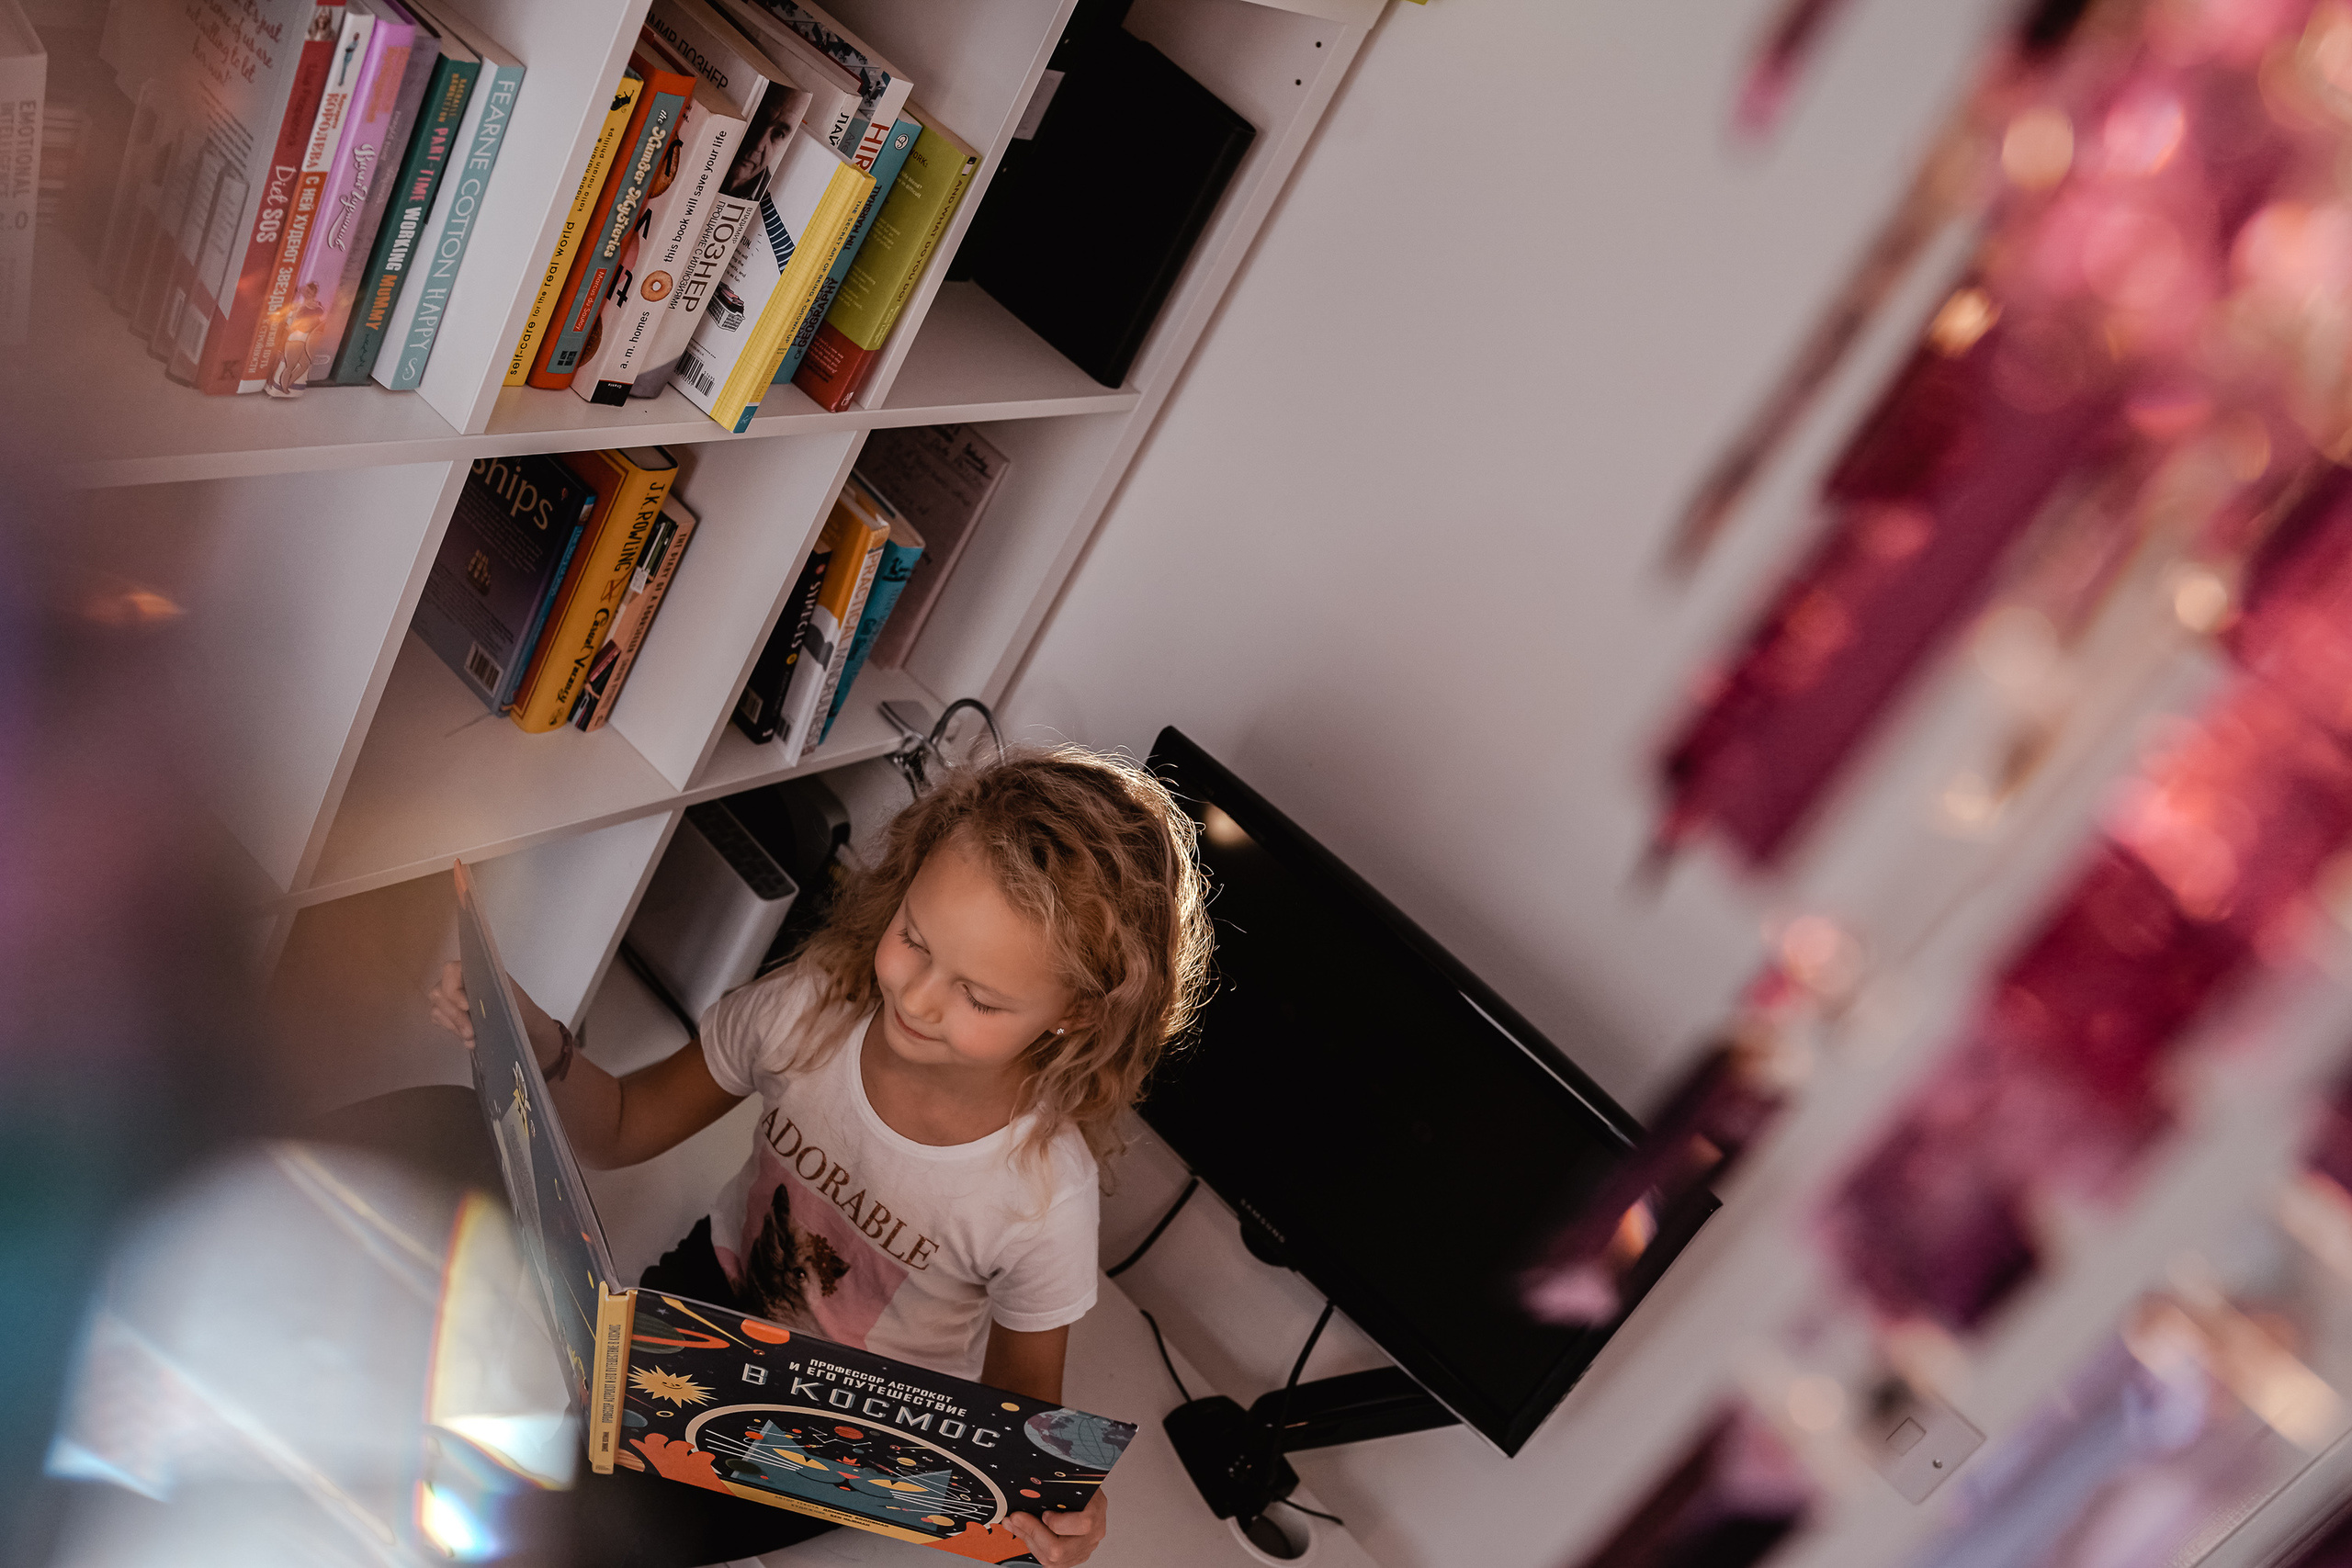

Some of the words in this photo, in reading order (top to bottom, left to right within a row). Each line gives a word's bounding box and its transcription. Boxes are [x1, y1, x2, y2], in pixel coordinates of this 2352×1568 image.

[307, 93, 340, 169] КОРОЛЕВА
[469, 80, 515, 170] FEARNE
[657, 109, 668, 124] the
[14, 100, 36, 198] EMOTIONAL
[600, 128, 615, 159] phillips
[267, 165, 297, 206] Diet
[298, 187, 317, 212] НЕЙ
[663, 244, 678, 263] this
[674, 218, 689, 244] book
[685, 197, 698, 220] will
[695, 175, 708, 197] save
[704, 150, 719, 175] your
[712, 130, 727, 150] life
[853, 199, 862, 215] THE
[949, 180, 963, 203] AND
[256, 208, 284, 243] SOS
[282, 214, 309, 265] ХУДЕЮТ
[385, 206, 423, 271] WORKING
[433, 178, 481, 277] COTTON
[604, 186, 642, 258] Mysteries
[836, 217, 854, 247] SECRET
[842, 234, 857, 251] TIM
[931, 205, 950, 237] WHAT
[682, 203, 746, 312] ПОЗНЕР
[826, 246, 838, 263] ART
[919, 241, 932, 256] DO
[267, 267, 293, 315] ЗВЕЗДЫ
[366, 275, 397, 330] MUMMY
[511, 321, 536, 375] self-care
[538, 290, 548, 305] the
[545, 262, 560, 287] real
[555, 221, 575, 257] world
[593, 271, 605, 295] Marcus
[668, 256, 701, 310] ИЛЛЮЗИЯМИ
[808, 273, 826, 299] BEING
[410, 288, 447, 350] HAPPY
[628, 310, 650, 344] homes
[797, 278, 839, 348] GEOGRAPHY
[674, 534, 687, 547] THE
[661, 552, 678, 578] DIARY
[838, 551, 885, 649] PRACTICAL
[581, 607, 609, 655] Casual
[556, 651, 593, 705] Vacancy
[762, 1107, 940, 1270] ADORABLE
[788, 1361, 801, 1371] И
[806, 1366, 836, 1381] ЕГО
[842, 1376, 967, 1417] ПУТЕШЕСТВИЕ
[809, 1359, 885, 1384] ПРОФЕССОР
[888, 1381, 954, 1403] АСТРОКОТ
[741, 1362, 769, 1385] В
[790, 1376, 1001, 1449] КОСМОС
